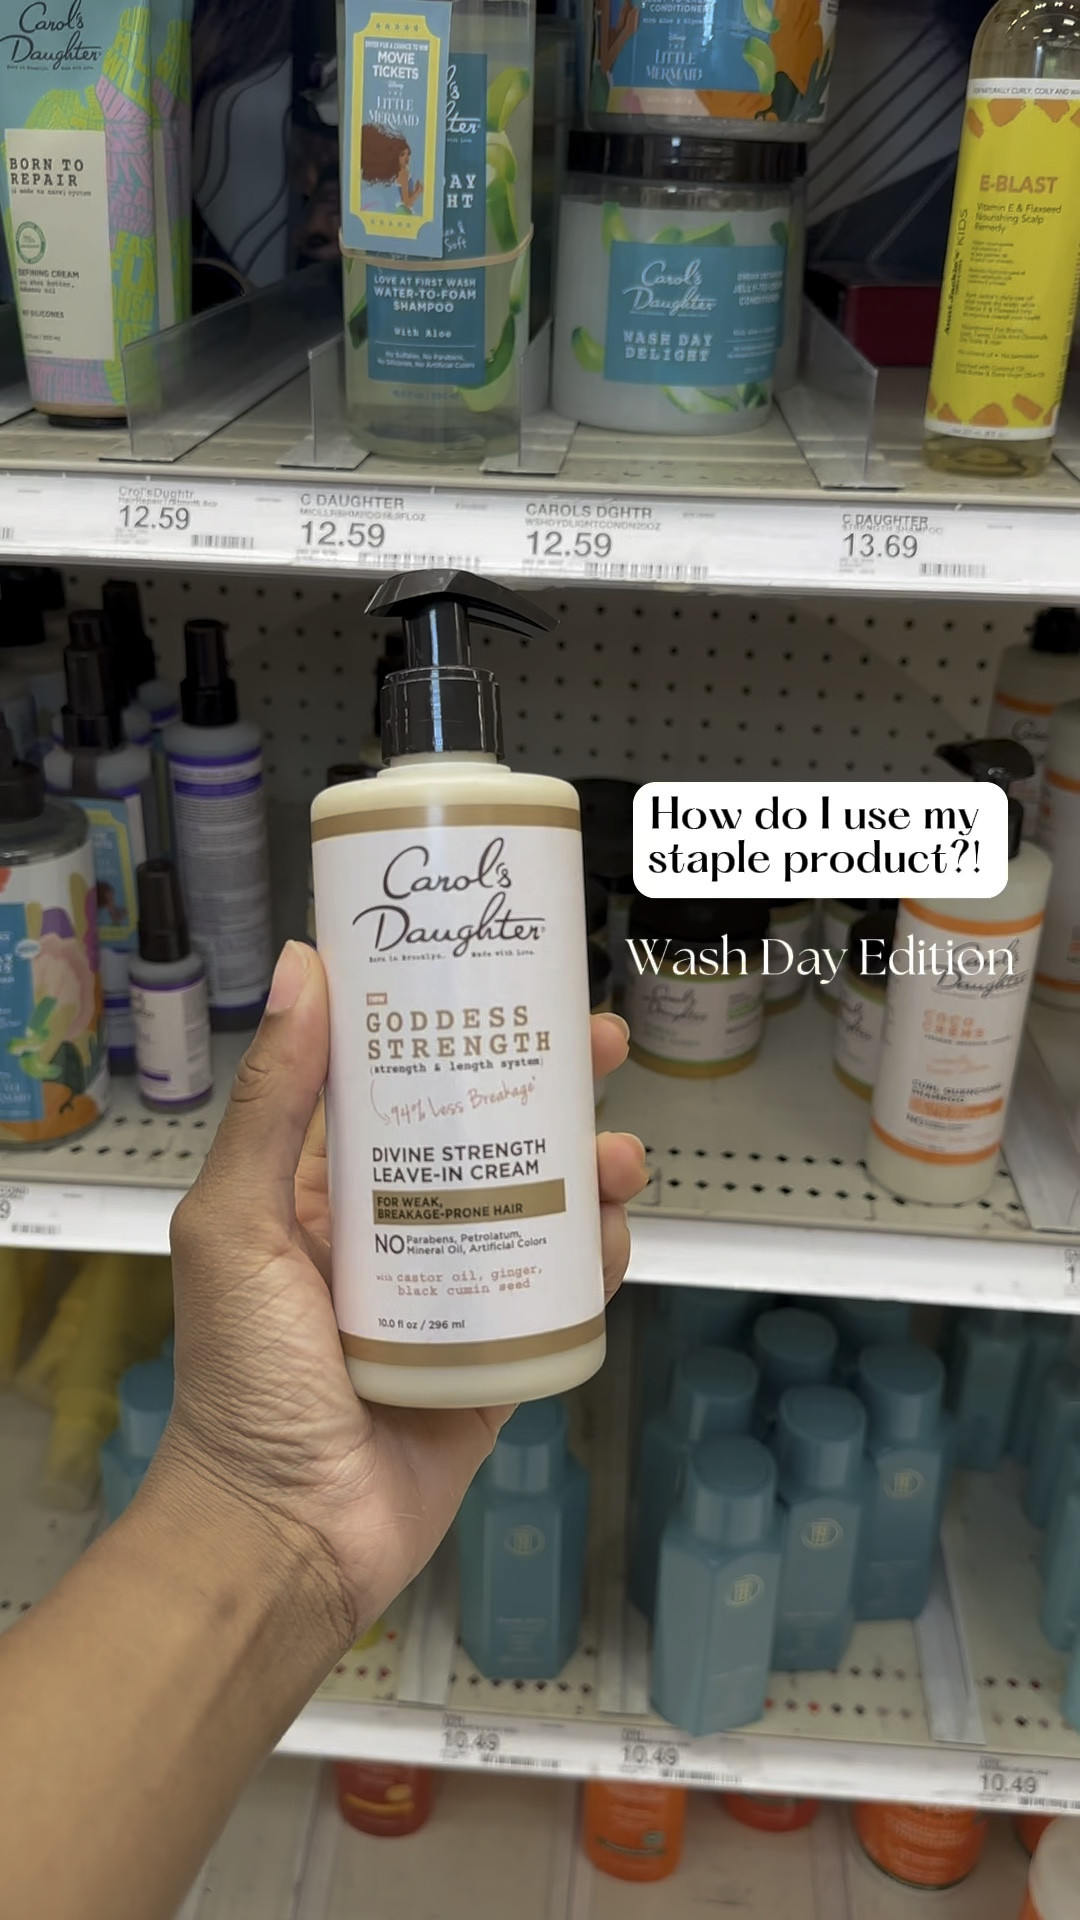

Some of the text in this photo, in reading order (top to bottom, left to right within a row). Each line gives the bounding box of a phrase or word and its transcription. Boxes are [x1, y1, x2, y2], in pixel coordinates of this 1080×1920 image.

[19, 0, 85, 34] Carol's
[0, 30, 103, 71] Daughter
[377, 51, 415, 65] MOVIE
[654, 49, 696, 65] LITTLE
[372, 65, 419, 80] TICKETS
[645, 64, 703, 86] MERMAID
[376, 95, 414, 112] LITTLE
[368, 109, 419, 128] MERMAID
[9, 157, 84, 172] BORN TO
[10, 172, 78, 188] REPAIR
[979, 174, 1059, 194] E-BLAST
[976, 202, 1006, 212] Vitamin
[1007, 203, 1014, 212] E
[1025, 204, 1062, 214] Flaxseed
[956, 208, 968, 246] KIDS
[975, 212, 1044, 226] Nourishing Scalp
[51, 270, 79, 279] CREAM
[374, 275, 476, 287] LOVE AT FIRST WASH
[641, 257, 702, 287] Carol's
[373, 286, 476, 300] WATER-TO-FOAM
[622, 285, 718, 317] Daughter
[393, 301, 454, 313] SHAMPOO
[425, 328, 452, 338] Aloe
[623, 329, 714, 347] WASH DAY
[625, 346, 710, 362] DELIGHT
[300, 493, 405, 510] C DAUGHTER
[119, 504, 191, 531] 12.59
[526, 503, 653, 520] CAROLS DGHTR
[842, 514, 929, 528] C DAUGHTER
[301, 520, 386, 548] 12.59
[527, 530, 613, 558] 12.59
[843, 532, 919, 559] 13.69
[383, 837, 512, 900] Carol's
[352, 891, 545, 959] Daughter
[366, 1005, 529, 1033] GODDESS
[367, 1031, 551, 1060] STRENGTH
[369, 1057, 544, 1076] (strength & length system)
[390, 1099, 426, 1126] 94%
[427, 1096, 465, 1118] Less
[372, 1138, 546, 1163] DIVINE STRENGTH
[372, 1159, 540, 1184] LEAVE-IN CREAM
[376, 1196, 444, 1208] FOR WEAK,
[377, 1203, 524, 1220] BREAKAGE-PRONE HAIR
[375, 1233, 405, 1255] NO
[406, 1230, 522, 1246] Parabens, Petrolatum,
[406, 1236, 547, 1256] Mineral Oil, Artificial Colors
[397, 1272, 444, 1283] castor
[451, 1271, 483, 1282] oil,
[490, 1265, 542, 1282] ginger,
[397, 1278, 531, 1296] black cumin seed
[377, 1318, 396, 1328] 10.0
[397, 1319, 405, 1328] fl
[428, 1320, 449, 1330] 296
[451, 1319, 466, 1330] ml
[442, 1729, 501, 1753] 10.49
[622, 1745, 681, 1765] 10.49
[981, 1772, 1039, 1793] 10.49
